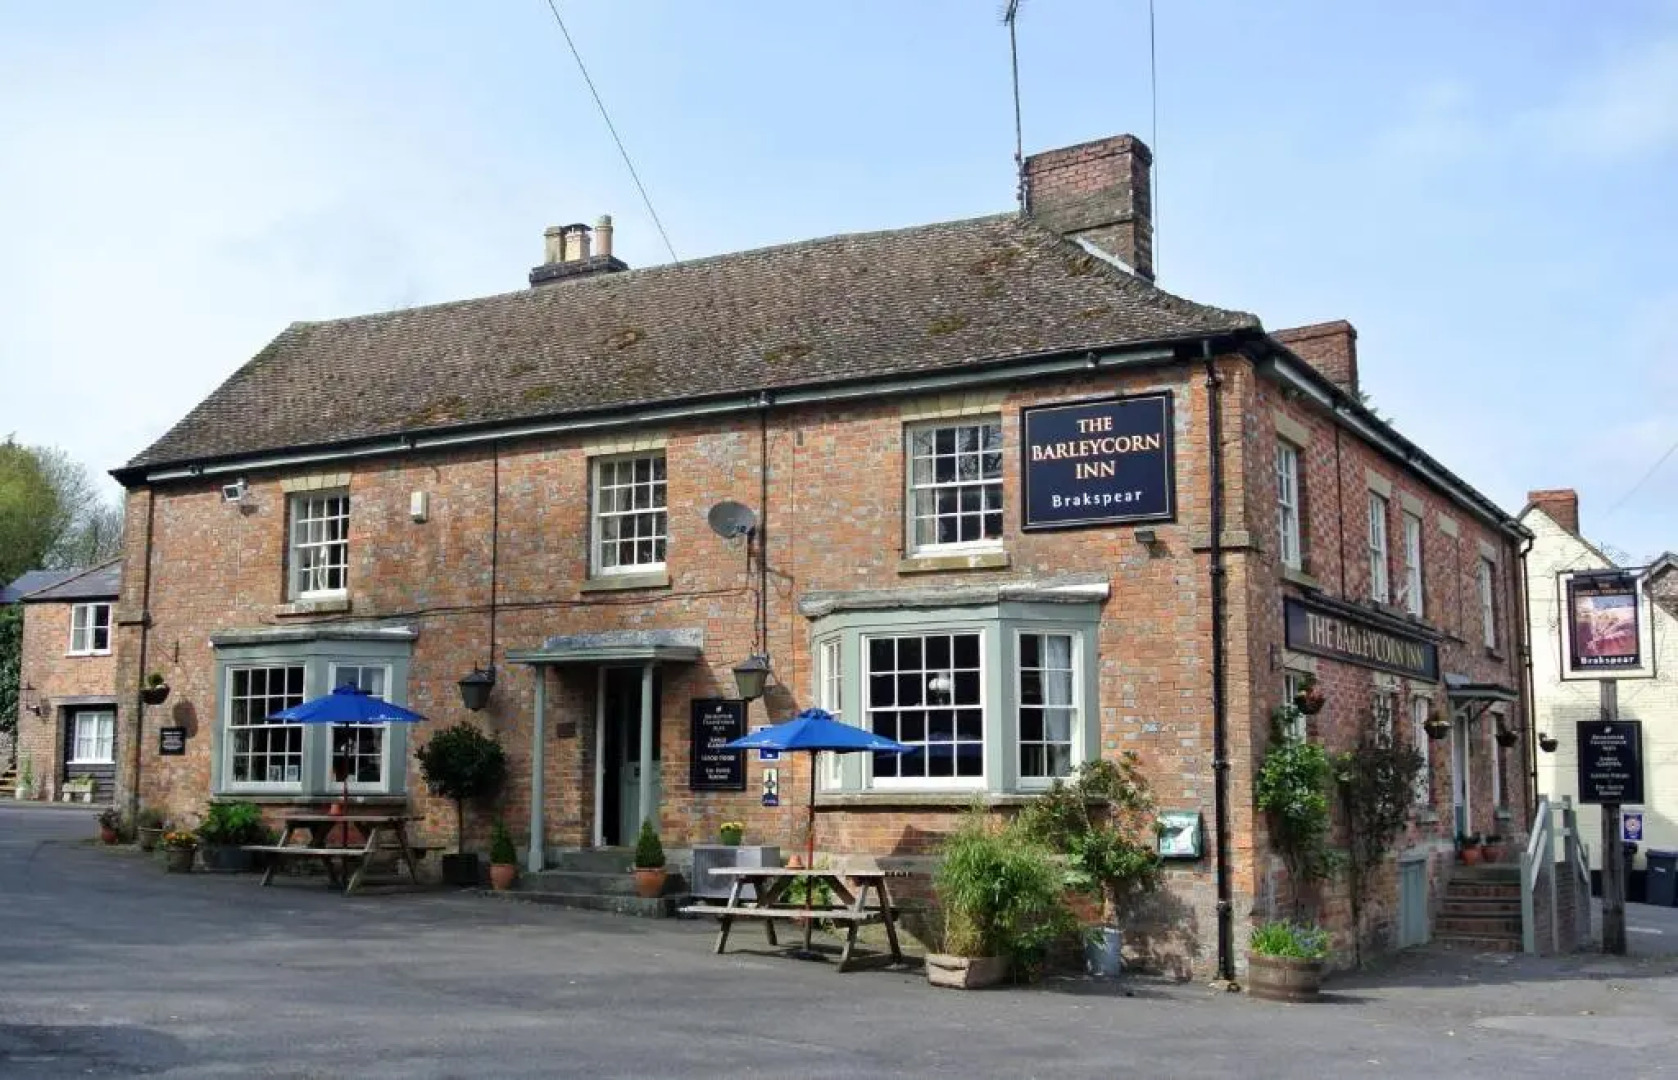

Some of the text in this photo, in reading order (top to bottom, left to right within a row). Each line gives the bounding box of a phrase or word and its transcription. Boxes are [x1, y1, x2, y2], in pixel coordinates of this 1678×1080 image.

[1076, 416, 1113, 433] THE
[1031, 433, 1161, 461] BARLEYCORN
[1075, 460, 1116, 480] INN
[1051, 491, 1143, 508] Brakspear
[1306, 612, 1425, 669] THE BARLEYCORN INN
